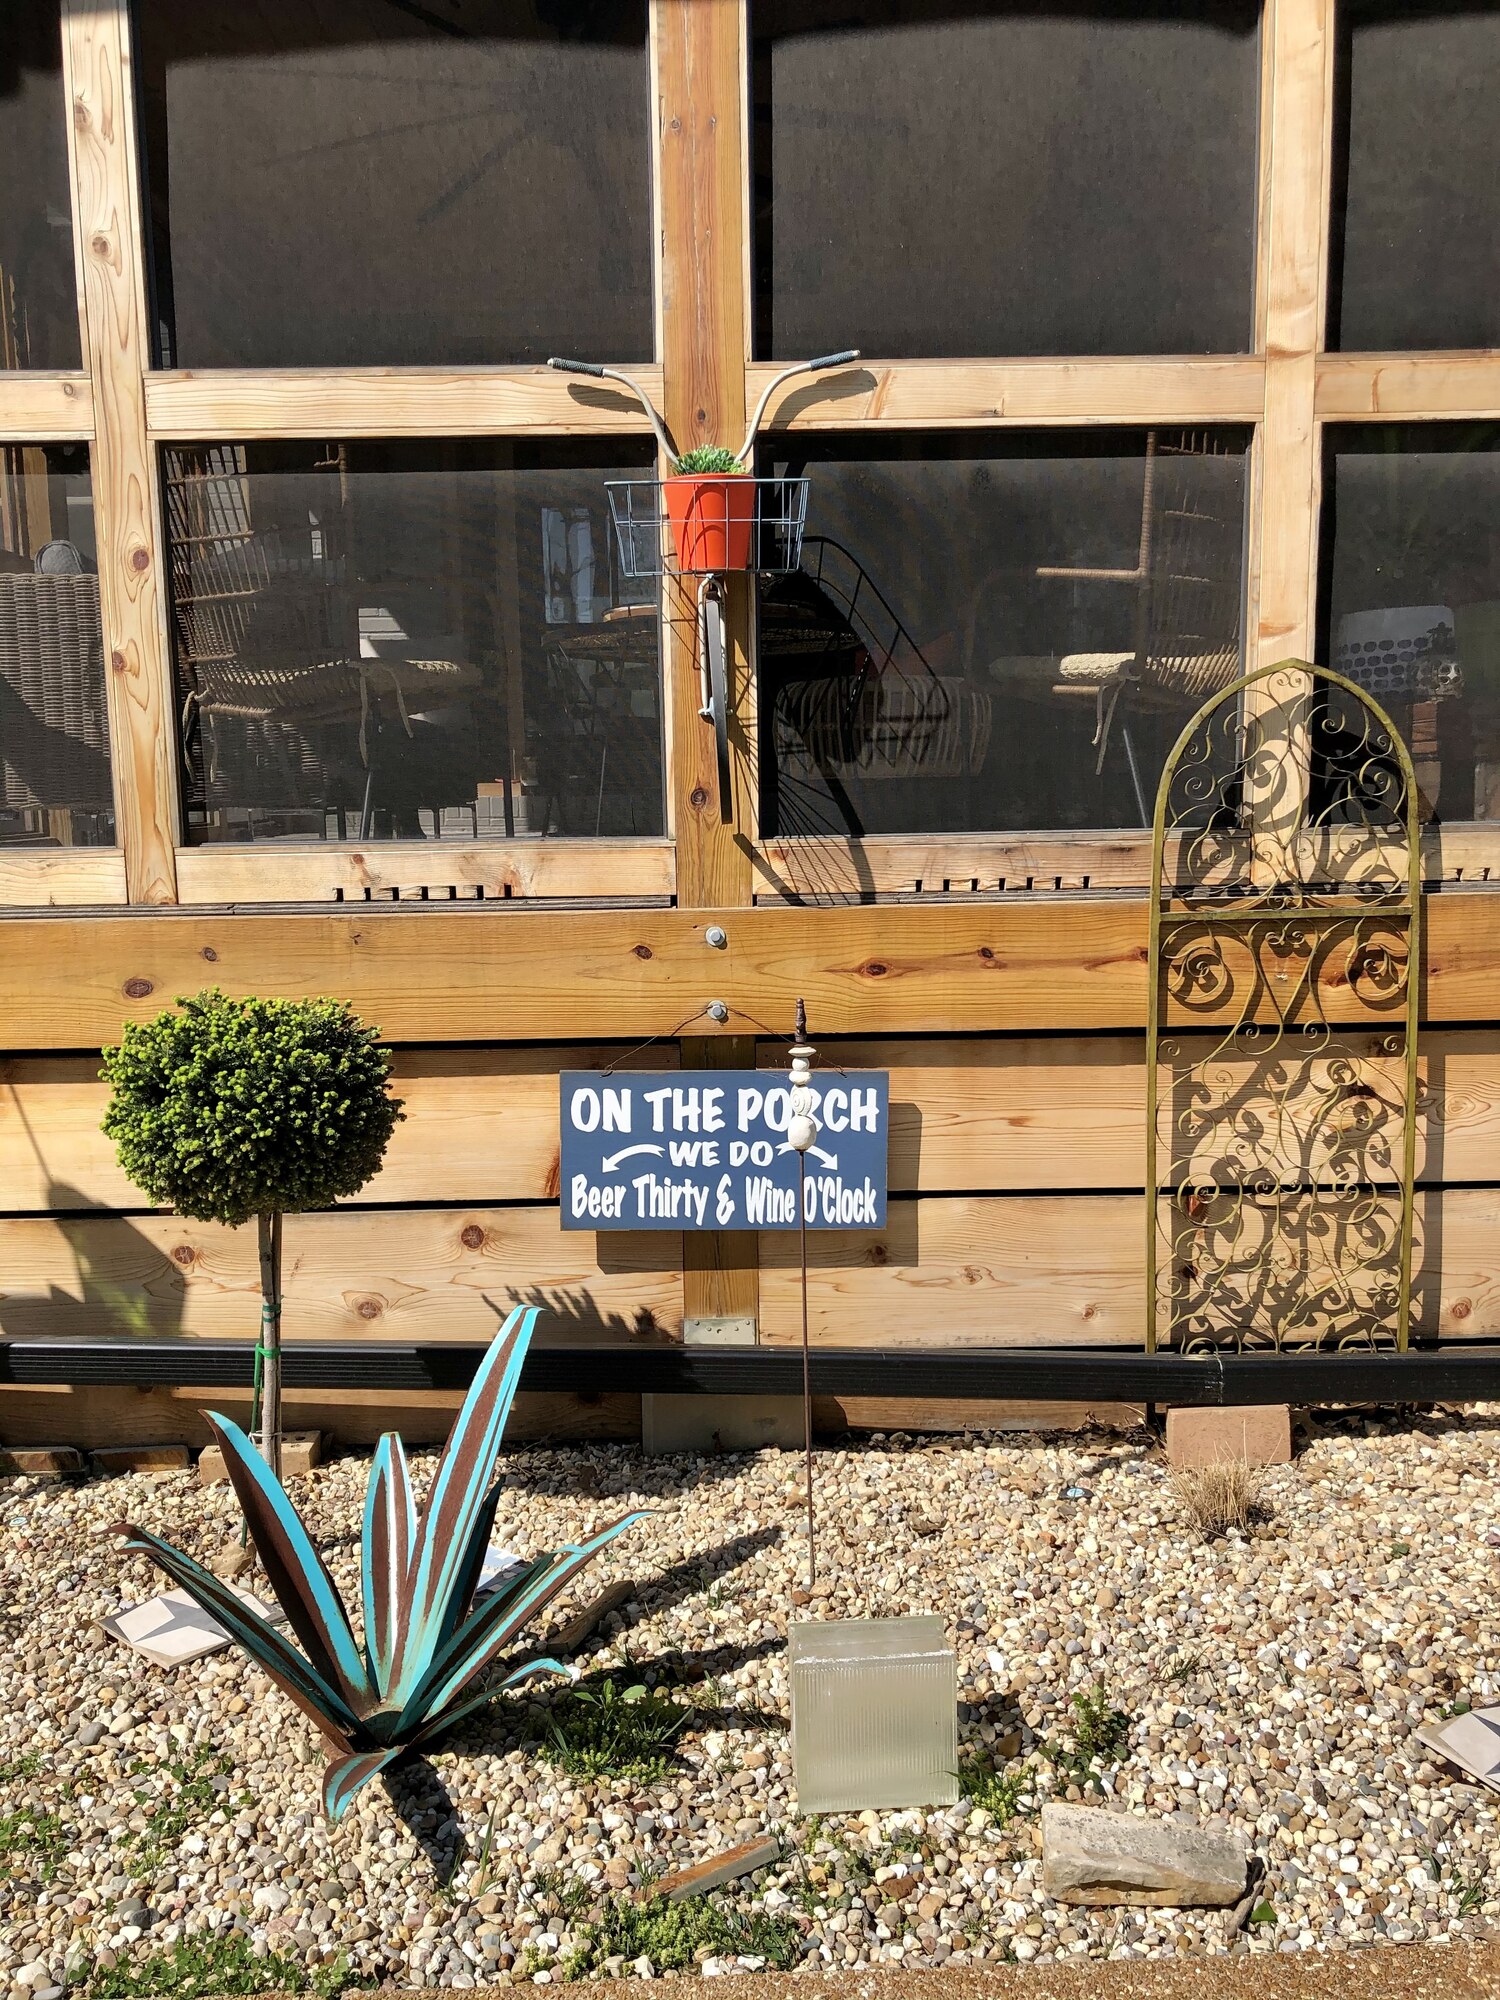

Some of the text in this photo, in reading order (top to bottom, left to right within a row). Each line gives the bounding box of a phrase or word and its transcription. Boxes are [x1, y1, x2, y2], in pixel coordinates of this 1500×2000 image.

[571, 1087, 632, 1133] ON
[643, 1087, 726, 1133] THE
[669, 1141, 774, 1167] WE DO
[571, 1173, 877, 1226] Beer Thirty & Wine O'Clock
